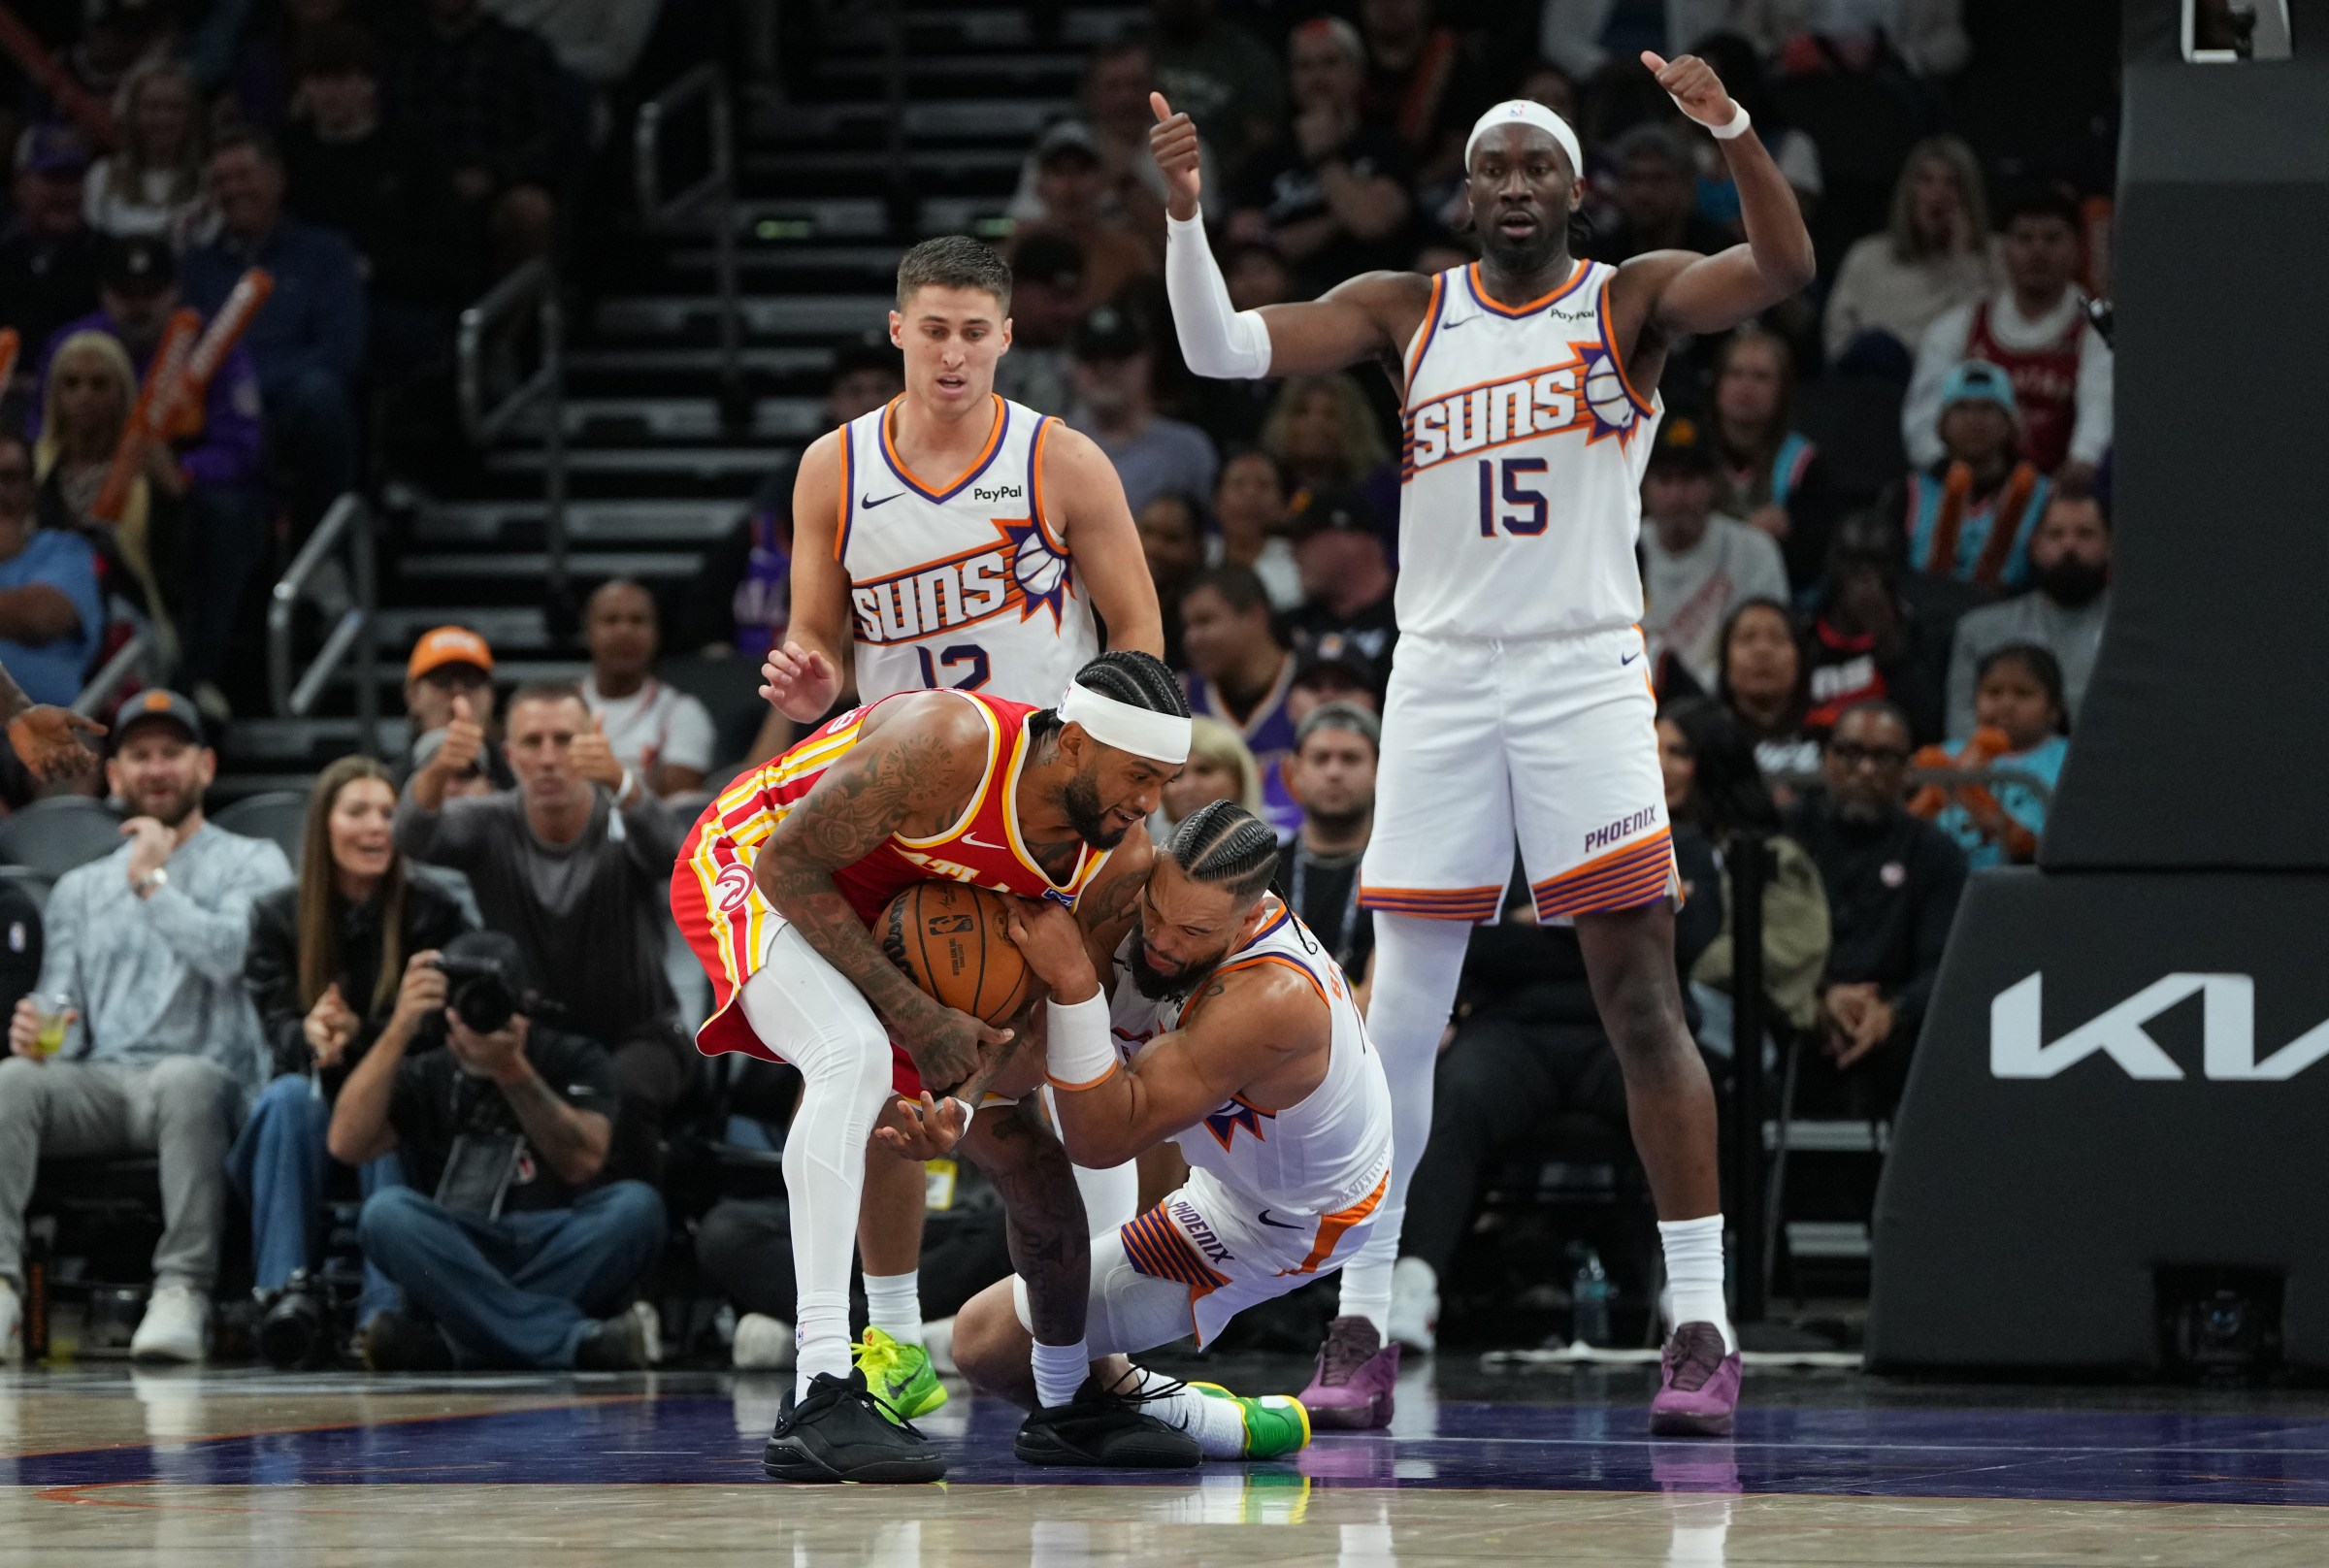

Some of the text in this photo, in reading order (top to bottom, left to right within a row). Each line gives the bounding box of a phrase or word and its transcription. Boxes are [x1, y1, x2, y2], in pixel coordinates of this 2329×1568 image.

[1550, 308, 1595, 322] PayPal
[1413, 368, 1577, 468] SUNS
[973, 484, 1022, 503] PayPal
[1478, 456, 1549, 538] 15
[851, 550, 1006, 642] SUNS
[915, 643, 992, 691] 12
[1584, 802, 1657, 854] PHOENIX
[1167, 1200, 1236, 1266] PHOENIX
